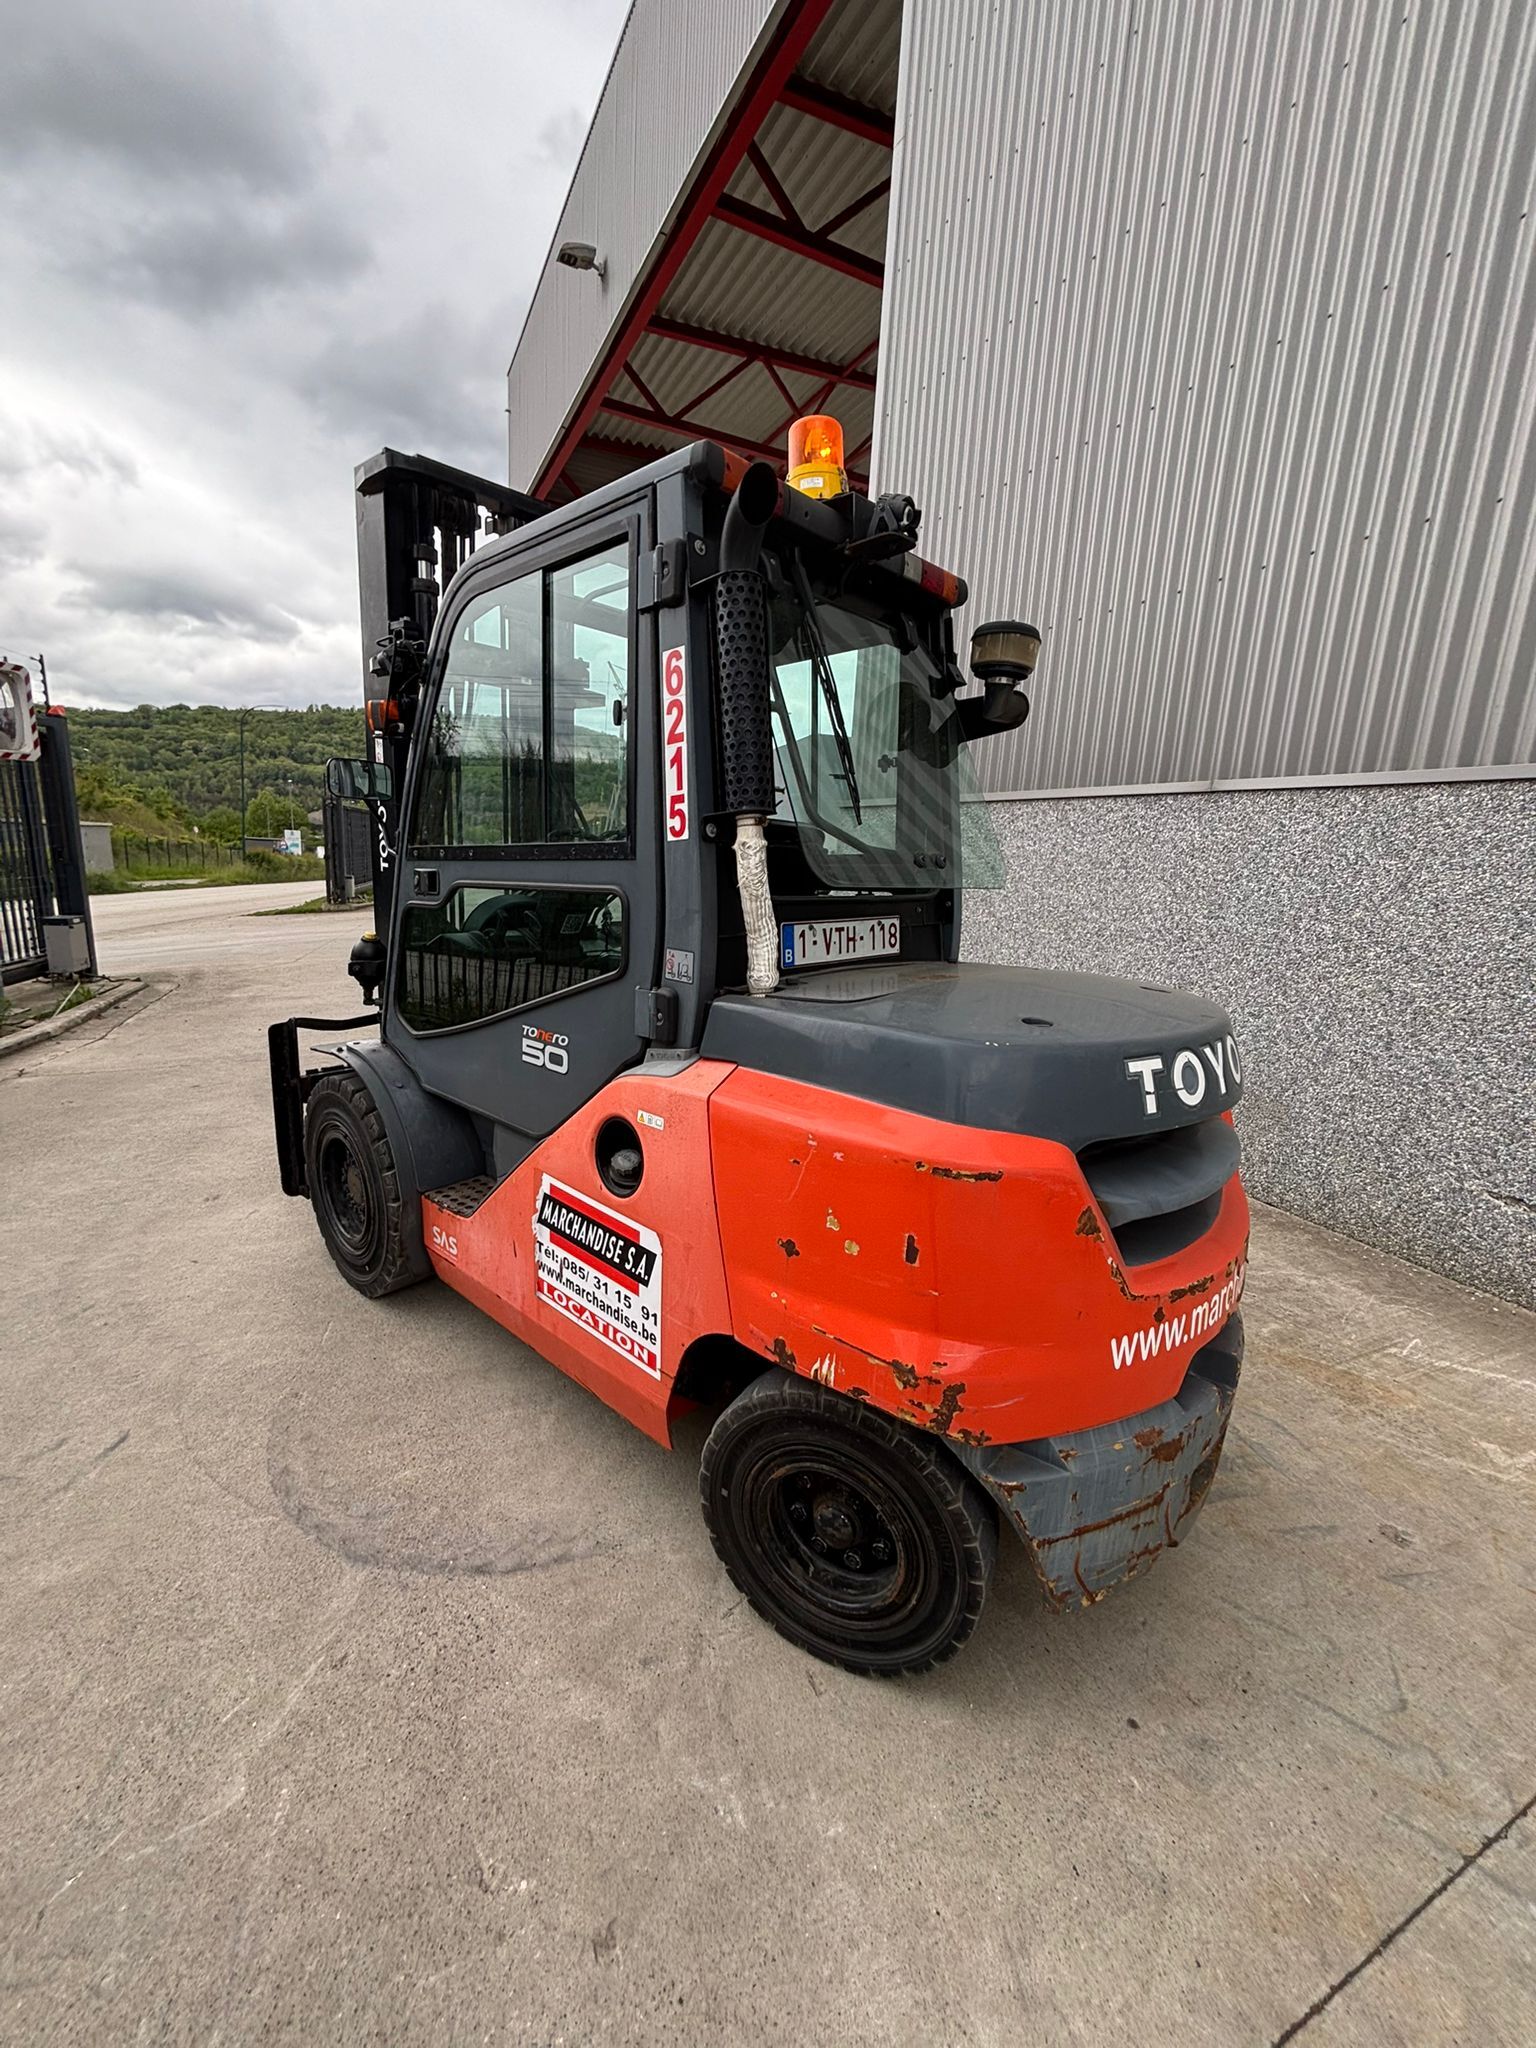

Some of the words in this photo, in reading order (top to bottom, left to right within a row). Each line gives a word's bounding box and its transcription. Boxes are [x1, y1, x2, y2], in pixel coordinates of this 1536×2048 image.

[665, 650, 687, 838] 6215
[377, 800, 389, 872] TOYO
[785, 949, 793, 963] B
[522, 1037, 569, 1075] 50
[1127, 1034, 1241, 1115] TOYO
[432, 1225, 457, 1256] SAS
[542, 1199, 622, 1263] MARCHANDISE
[624, 1243, 649, 1280] S.A.
[537, 1240, 559, 1264] Tél:
[562, 1257, 590, 1282] 085/
[593, 1275, 609, 1294] 31
[615, 1290, 632, 1309] 15
[641, 1306, 658, 1327] 91
[537, 1260, 657, 1346] www.marchandise.be
[542, 1283, 649, 1365] LOCATION
